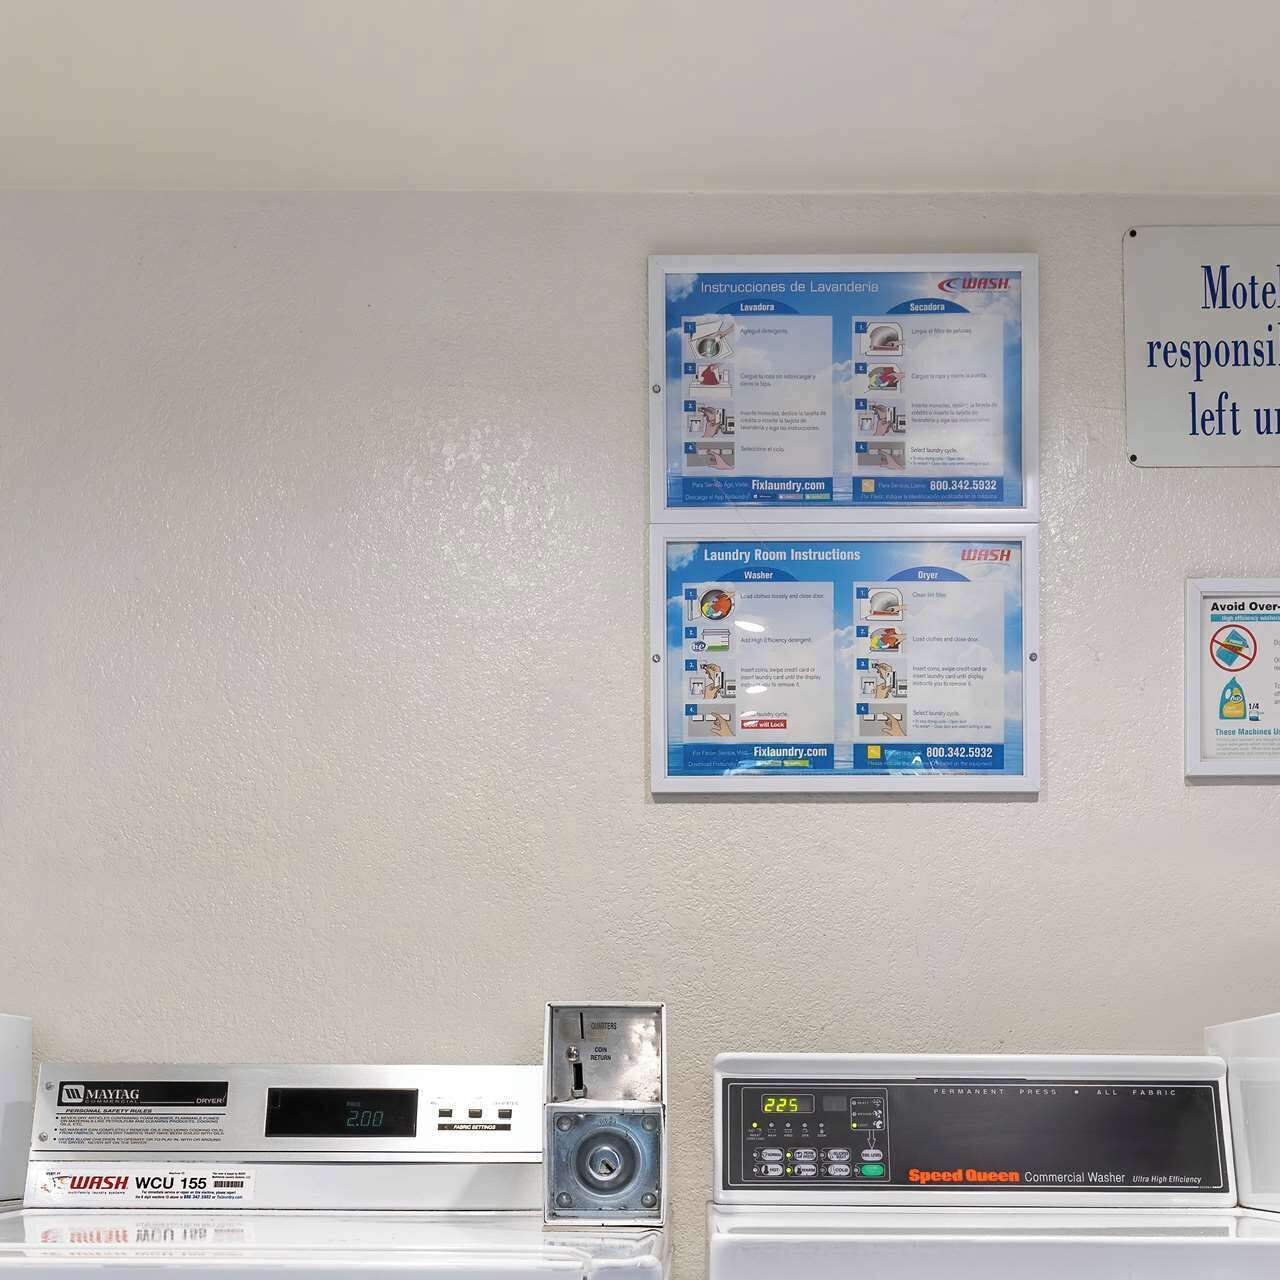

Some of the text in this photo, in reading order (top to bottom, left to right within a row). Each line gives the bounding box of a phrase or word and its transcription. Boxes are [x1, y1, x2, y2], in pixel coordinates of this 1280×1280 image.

[701, 281, 785, 293] Instrucciones
[790, 281, 805, 293] de
[962, 277, 1009, 289] WASH
[740, 303, 775, 311] Lavadora
[910, 303, 945, 311] Secadora
[1188, 391, 1241, 435] left
[752, 479, 825, 492] Fixlaundry.com
[930, 480, 997, 490] 800.342.5932
[704, 549, 860, 563] Laundry Room Instructions
[961, 549, 1011, 561] WASH
[744, 571, 773, 579] Washer
[918, 571, 938, 580] Dryer
[1211, 602, 1245, 611] Avoid
[754, 746, 827, 758] Fixlaundry.com
[927, 747, 992, 757] 800.342.5932
[86, 1089, 139, 1099] MAYTAG
[764, 1099, 798, 1112] 225
[346, 1111, 384, 1127] 2.00
[70, 1176, 129, 1189] WASH
[908, 1169, 1201, 1184] Speed Queen Commercial Washer Ultra High Efficiency
[135, 1177, 207, 1189] WCU 155
